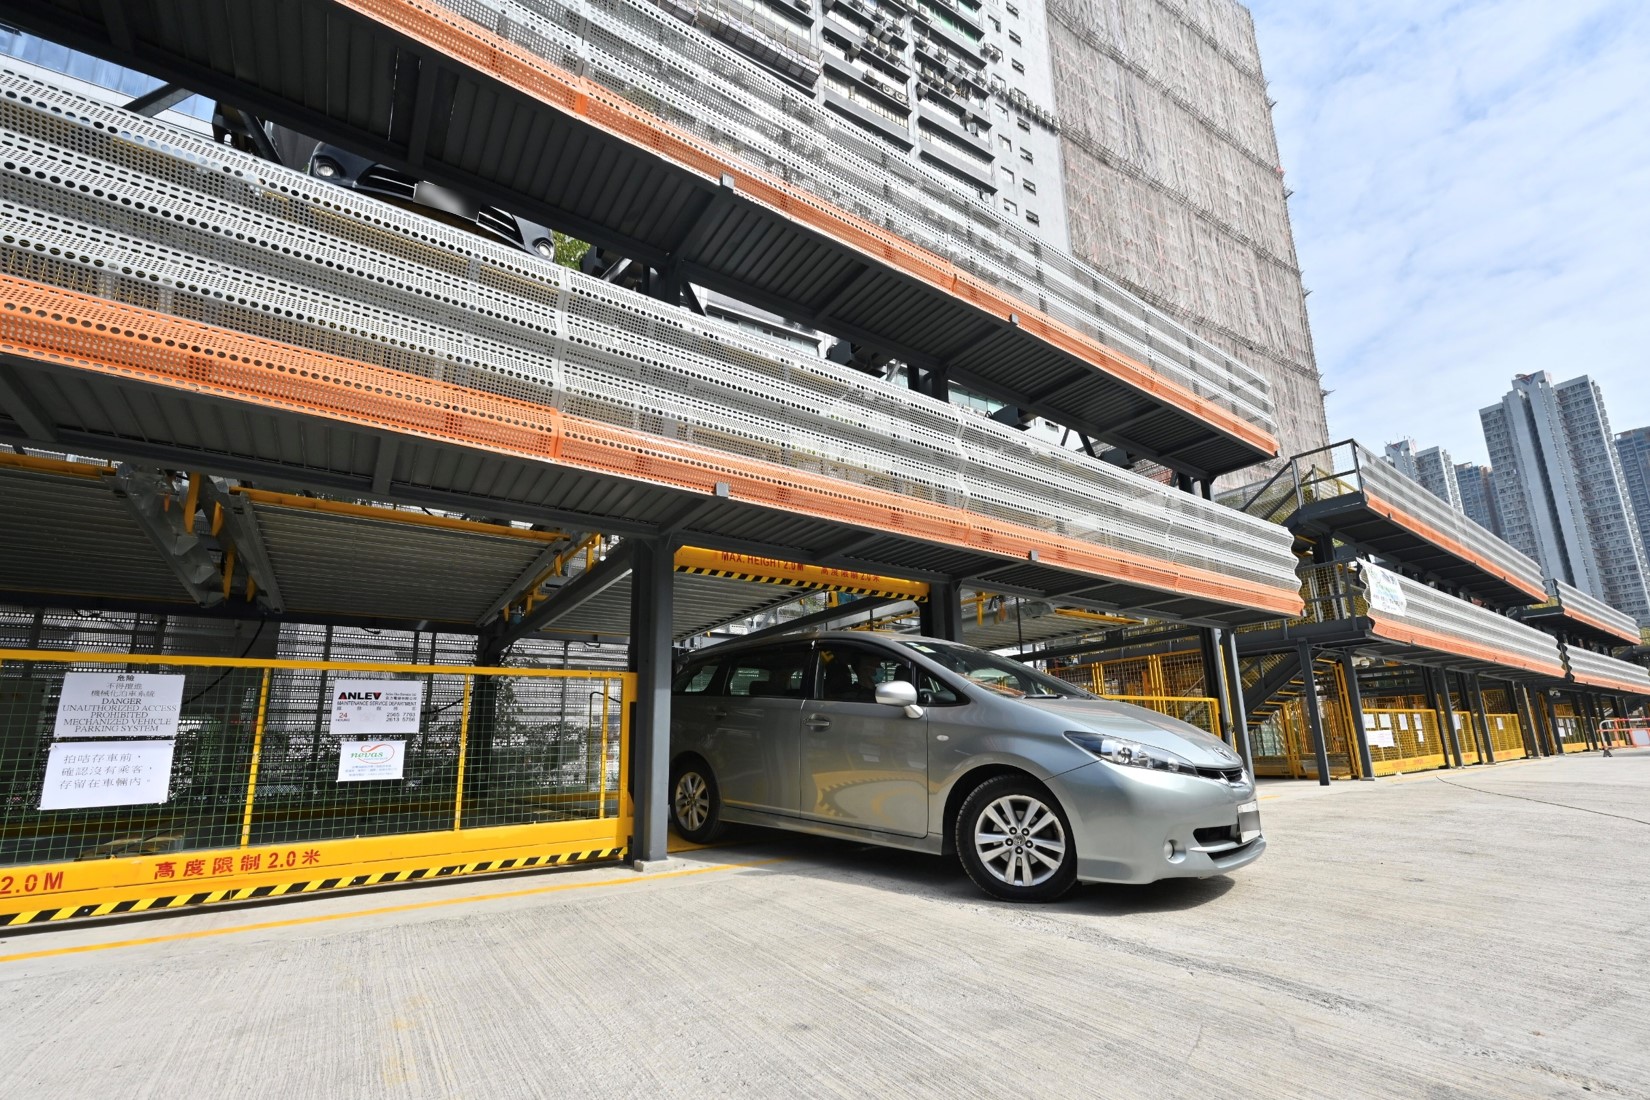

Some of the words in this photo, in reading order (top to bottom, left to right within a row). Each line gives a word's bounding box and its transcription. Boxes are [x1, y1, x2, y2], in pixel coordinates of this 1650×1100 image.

[338, 692, 382, 700] ANLEV
[101, 697, 142, 705] DANGER
[62, 704, 140, 712] UNAUTHORIZED
[90, 711, 149, 719] PROHIBITED
[63, 718, 130, 726] MECHANIZED
